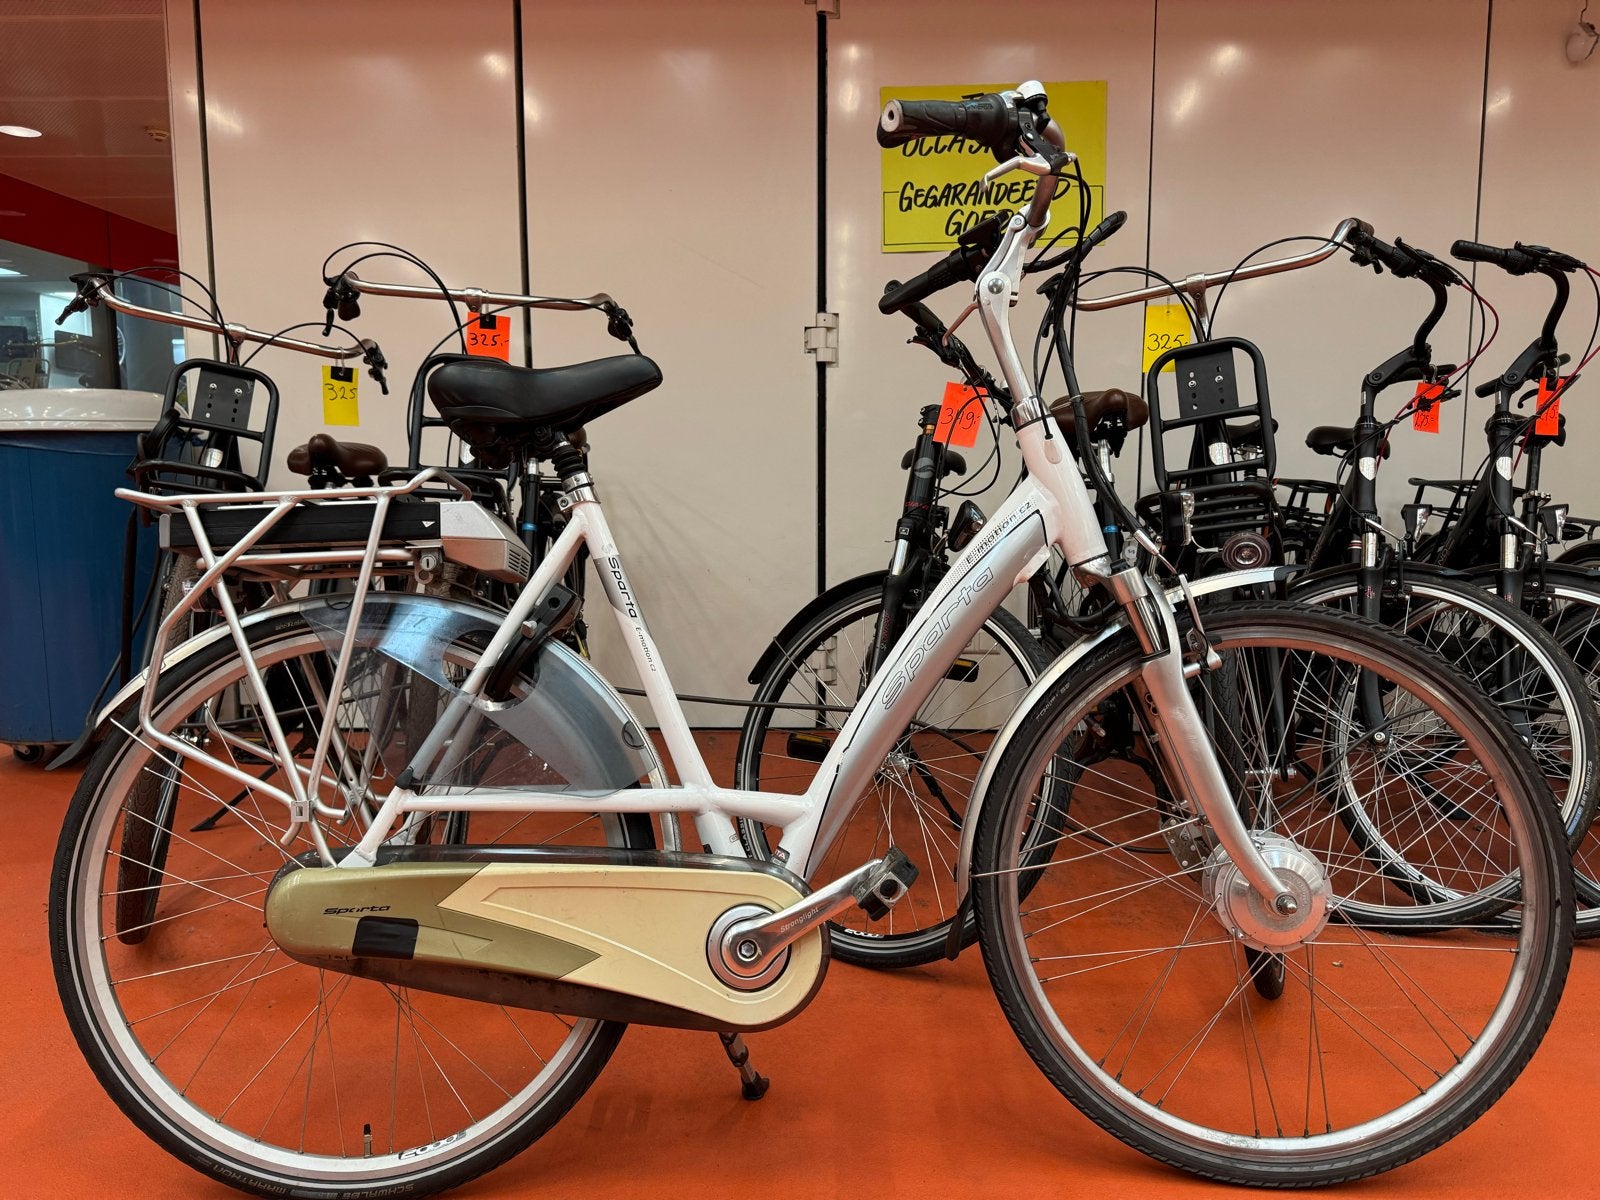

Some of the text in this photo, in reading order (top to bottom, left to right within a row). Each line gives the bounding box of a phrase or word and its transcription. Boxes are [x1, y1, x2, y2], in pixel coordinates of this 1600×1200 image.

[898, 179, 1071, 212] GEGARANDEED
[608, 556, 638, 619] Sparta
[635, 626, 653, 663] E-motion
[882, 567, 994, 710] Sparta
[323, 905, 391, 915] Sparta
[780, 906, 820, 933] Stronglight
